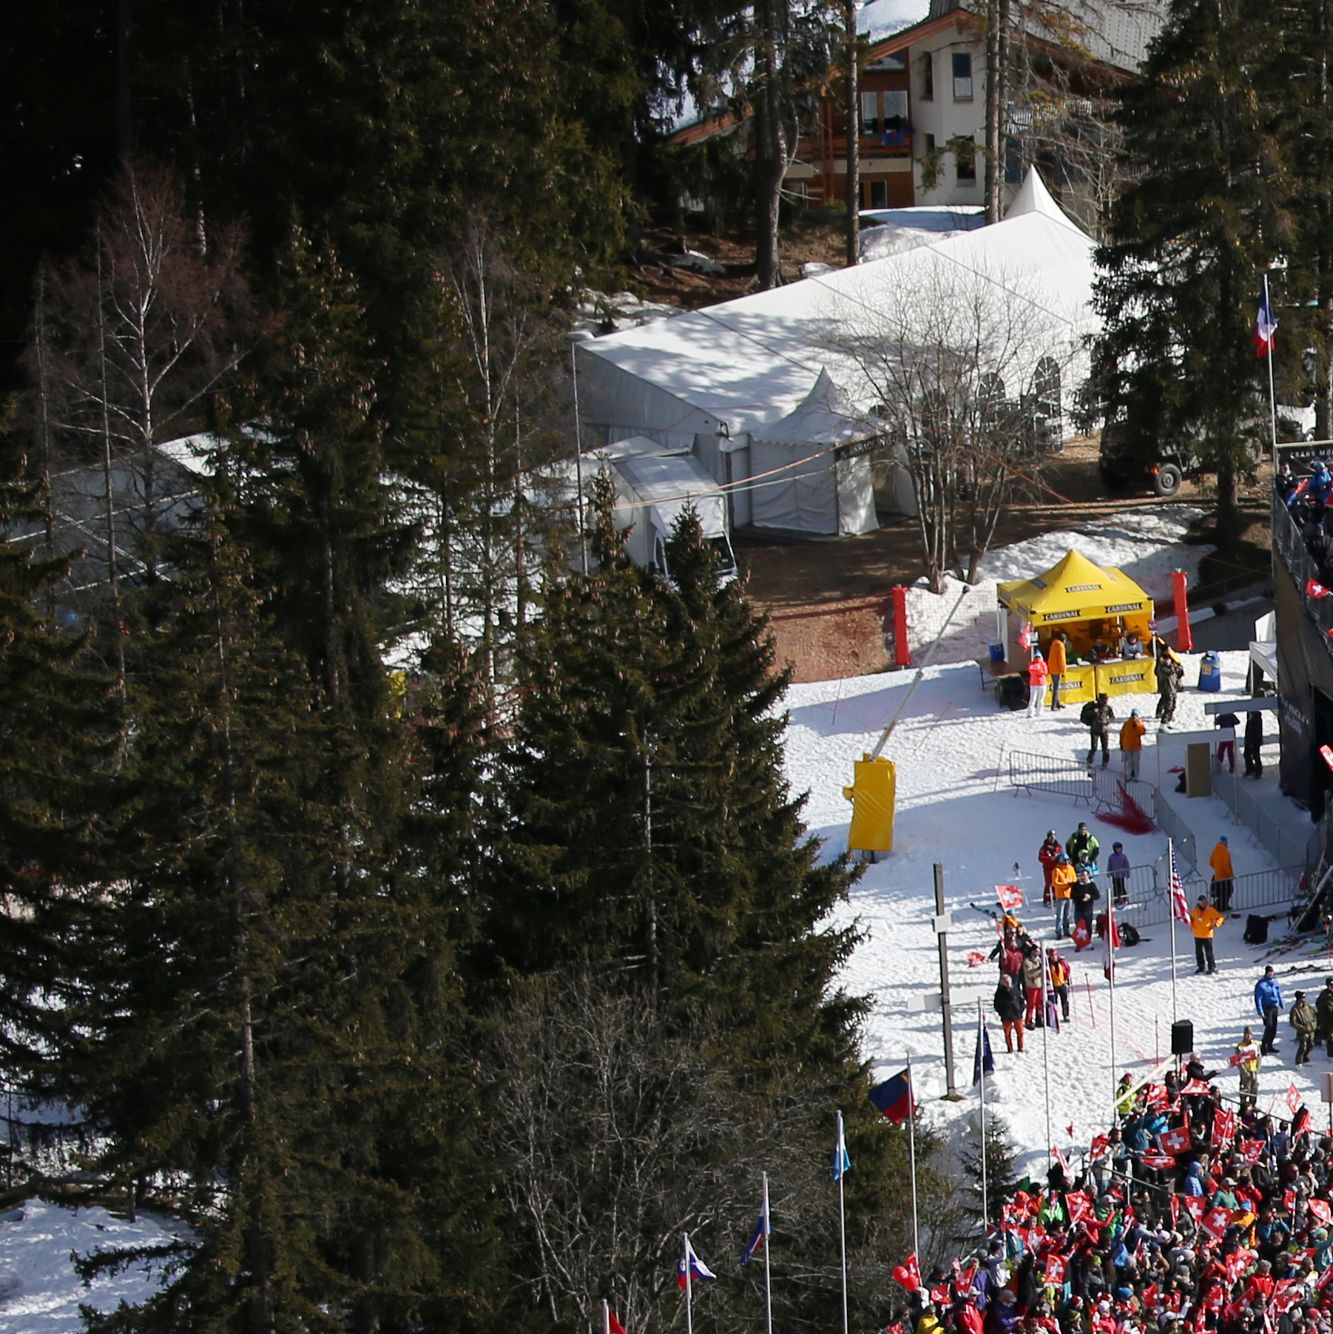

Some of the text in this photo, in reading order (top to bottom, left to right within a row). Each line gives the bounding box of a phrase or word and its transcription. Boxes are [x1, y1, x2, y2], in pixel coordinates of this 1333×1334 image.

[1107, 602, 1141, 613] CARDINAL
[1046, 610, 1079, 620] CARDINAL
[1112, 674, 1145, 684] CARDINAL
